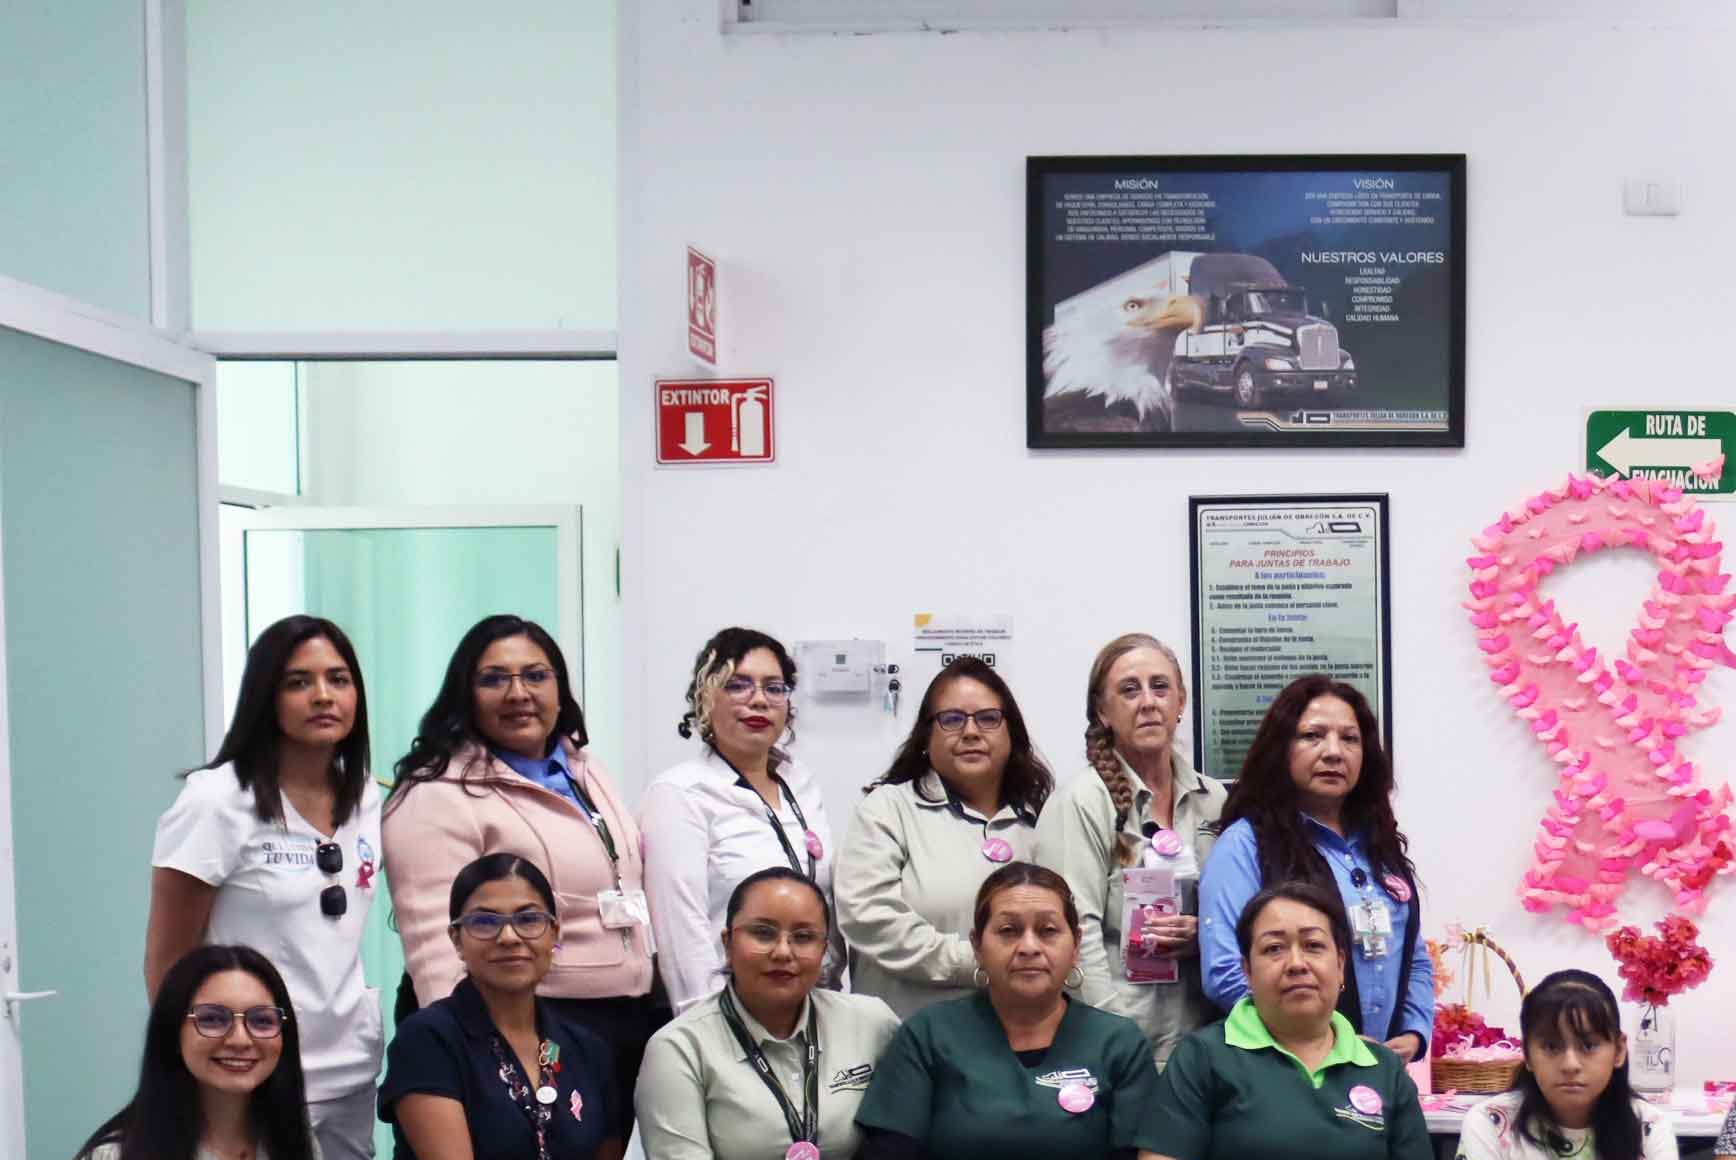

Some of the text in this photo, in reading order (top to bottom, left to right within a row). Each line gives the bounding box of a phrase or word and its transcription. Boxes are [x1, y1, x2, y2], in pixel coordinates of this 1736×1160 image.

[1114, 177, 1159, 190] MISIÓN
[1353, 177, 1395, 190] VISIÓN
[1301, 251, 1445, 263] NUESTROS VALORES
[661, 388, 731, 406] EXTINTOR
[1646, 415, 1706, 437] RUTA DE
[1264, 549, 1316, 558] PRINCIPIOS
[1229, 558, 1351, 568] PARA JUNTAS DE TRABAJO
[264, 852, 315, 865] TU VIDA
